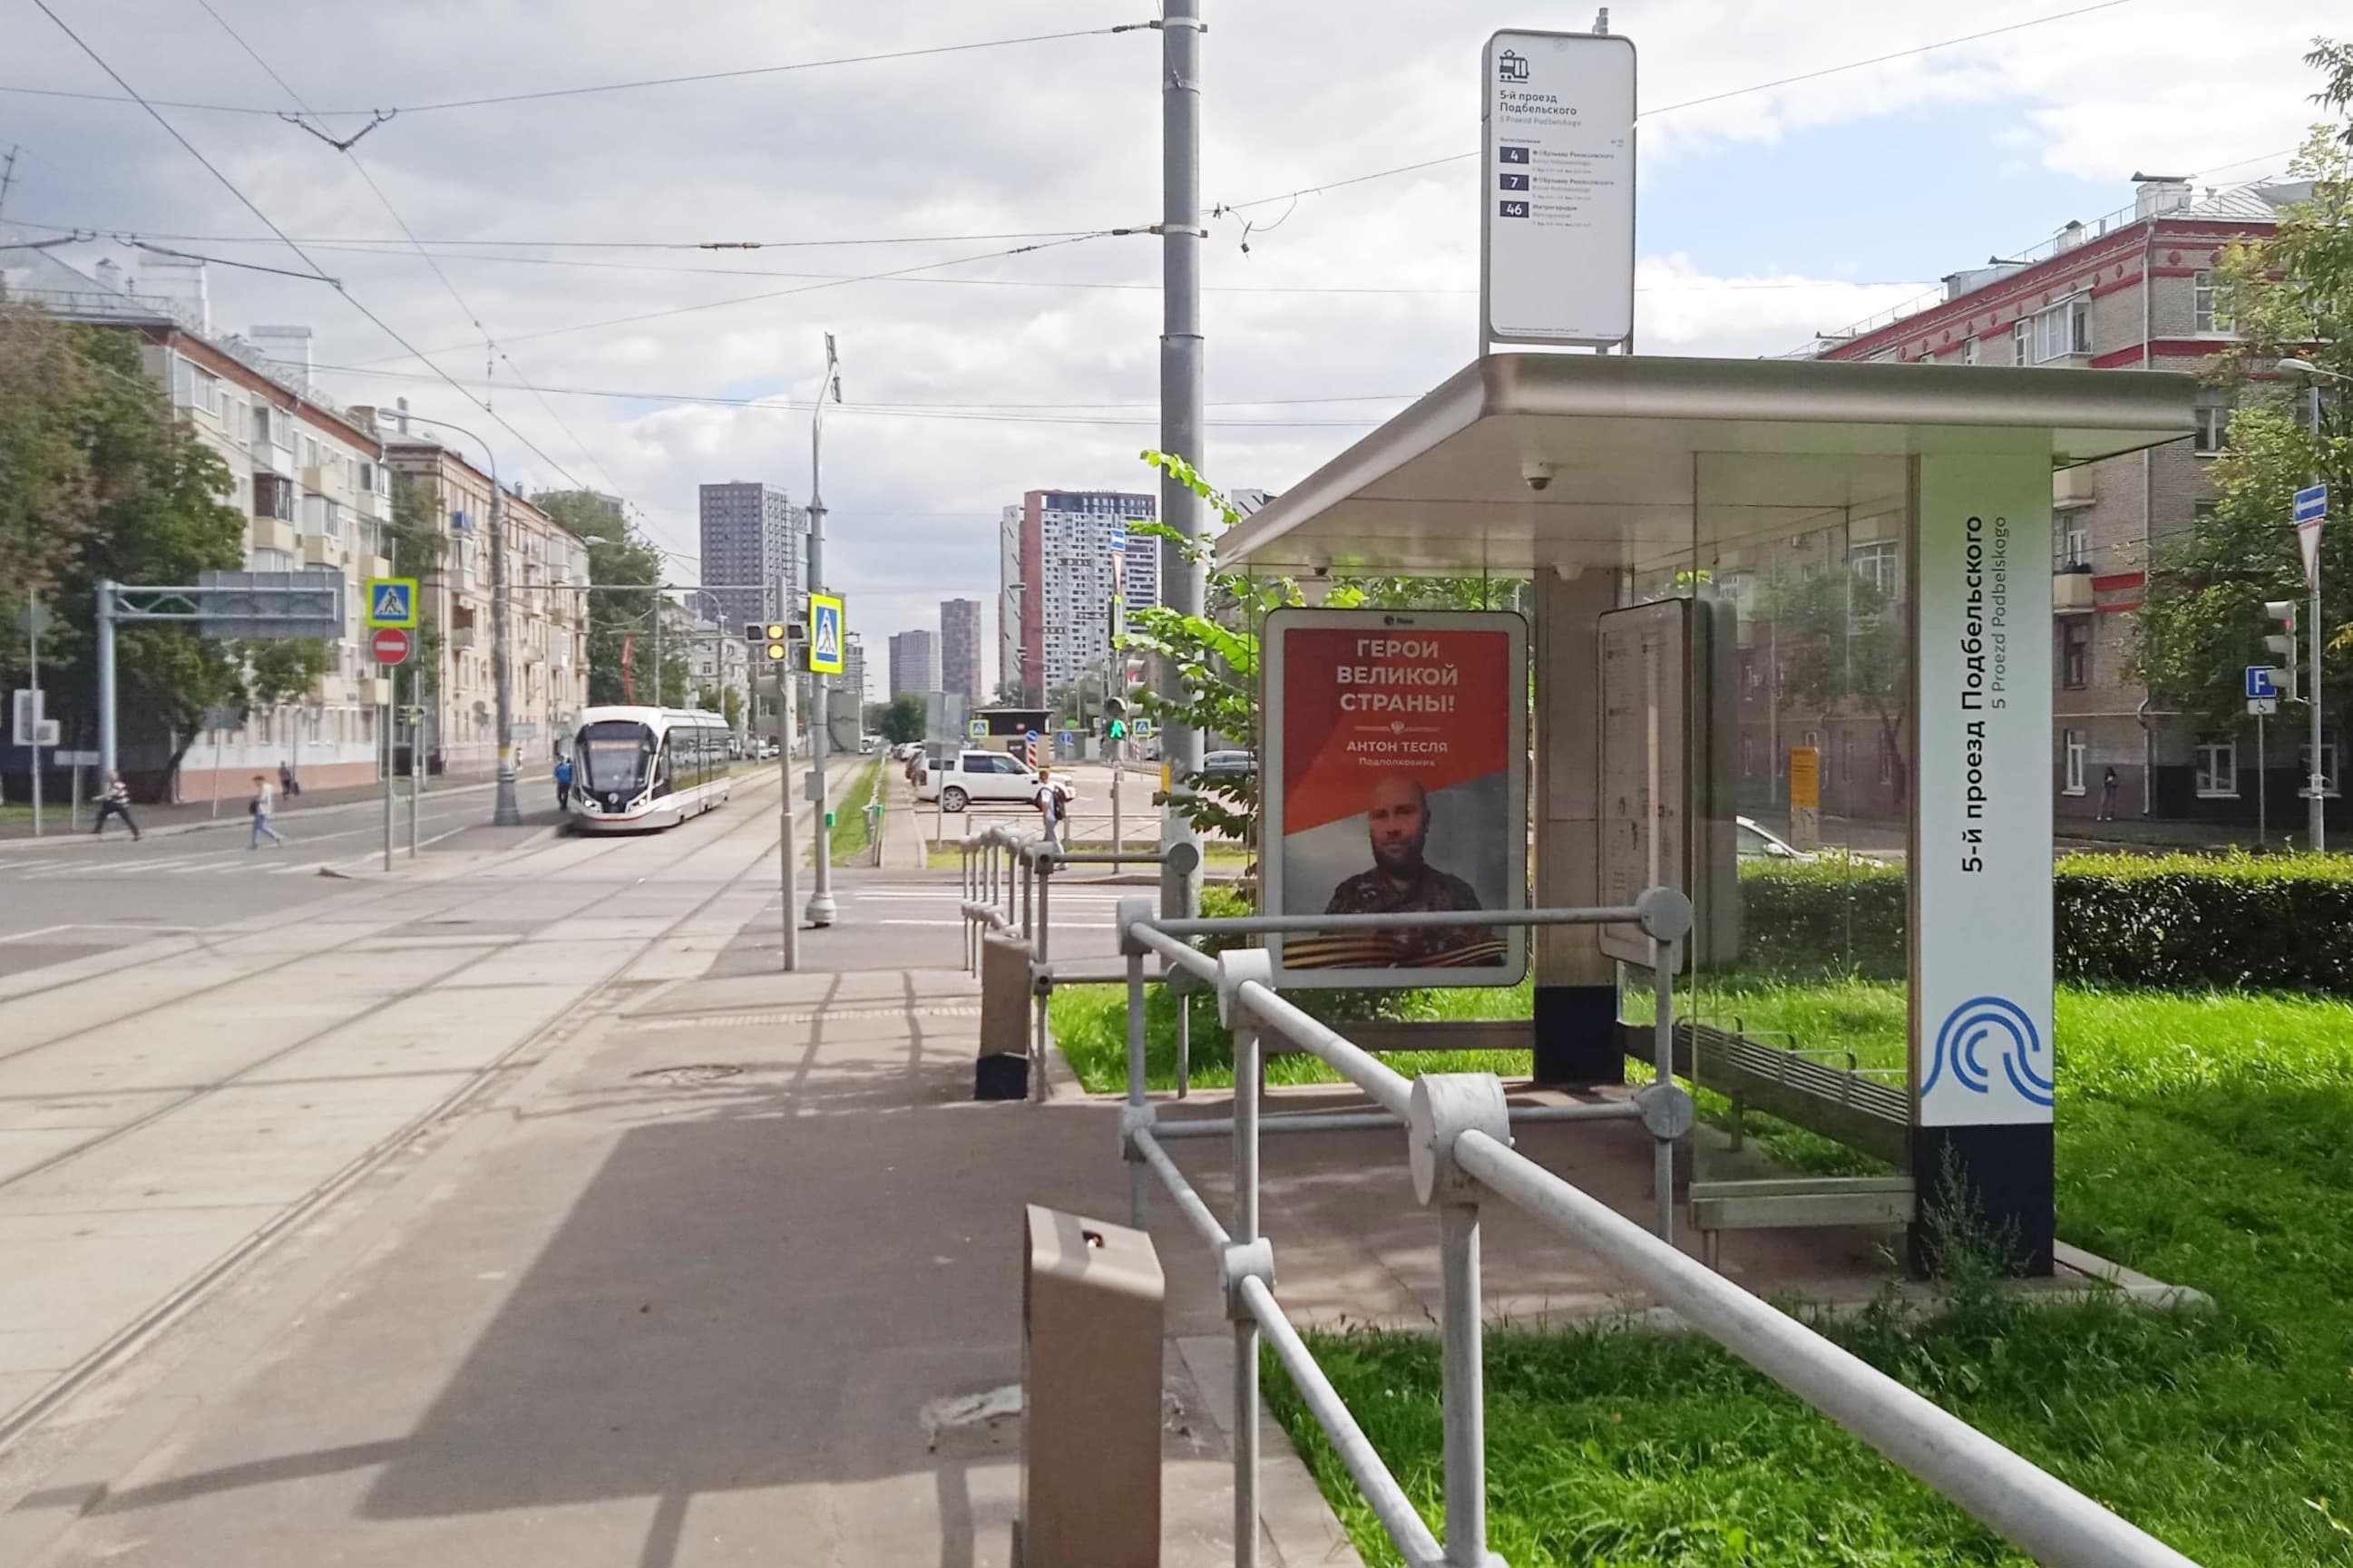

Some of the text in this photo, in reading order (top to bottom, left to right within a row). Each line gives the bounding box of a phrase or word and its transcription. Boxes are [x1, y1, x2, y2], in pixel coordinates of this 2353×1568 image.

[1499, 90, 1557, 103] 5-й проезд
[1499, 102, 1577, 115] Подбельского
[1510, 150, 1518, 161] 4
[1509, 176, 1518, 189] 7
[1506, 203, 1523, 216] 46
[1991, 516, 2010, 709] 5 Proezd Podbelskogo
[1356, 638, 1439, 658] ГЕРОИ
[1336, 663, 1458, 686] ВЕЛИКОЙ
[1961, 516, 1987, 872] 5-й проезд Подбельского
[1340, 693, 1455, 712] СТРАНЫ!
[1346, 740, 1448, 753] АНТОН ТЕСЛЯ
[1359, 756, 1436, 766] Подполковник
